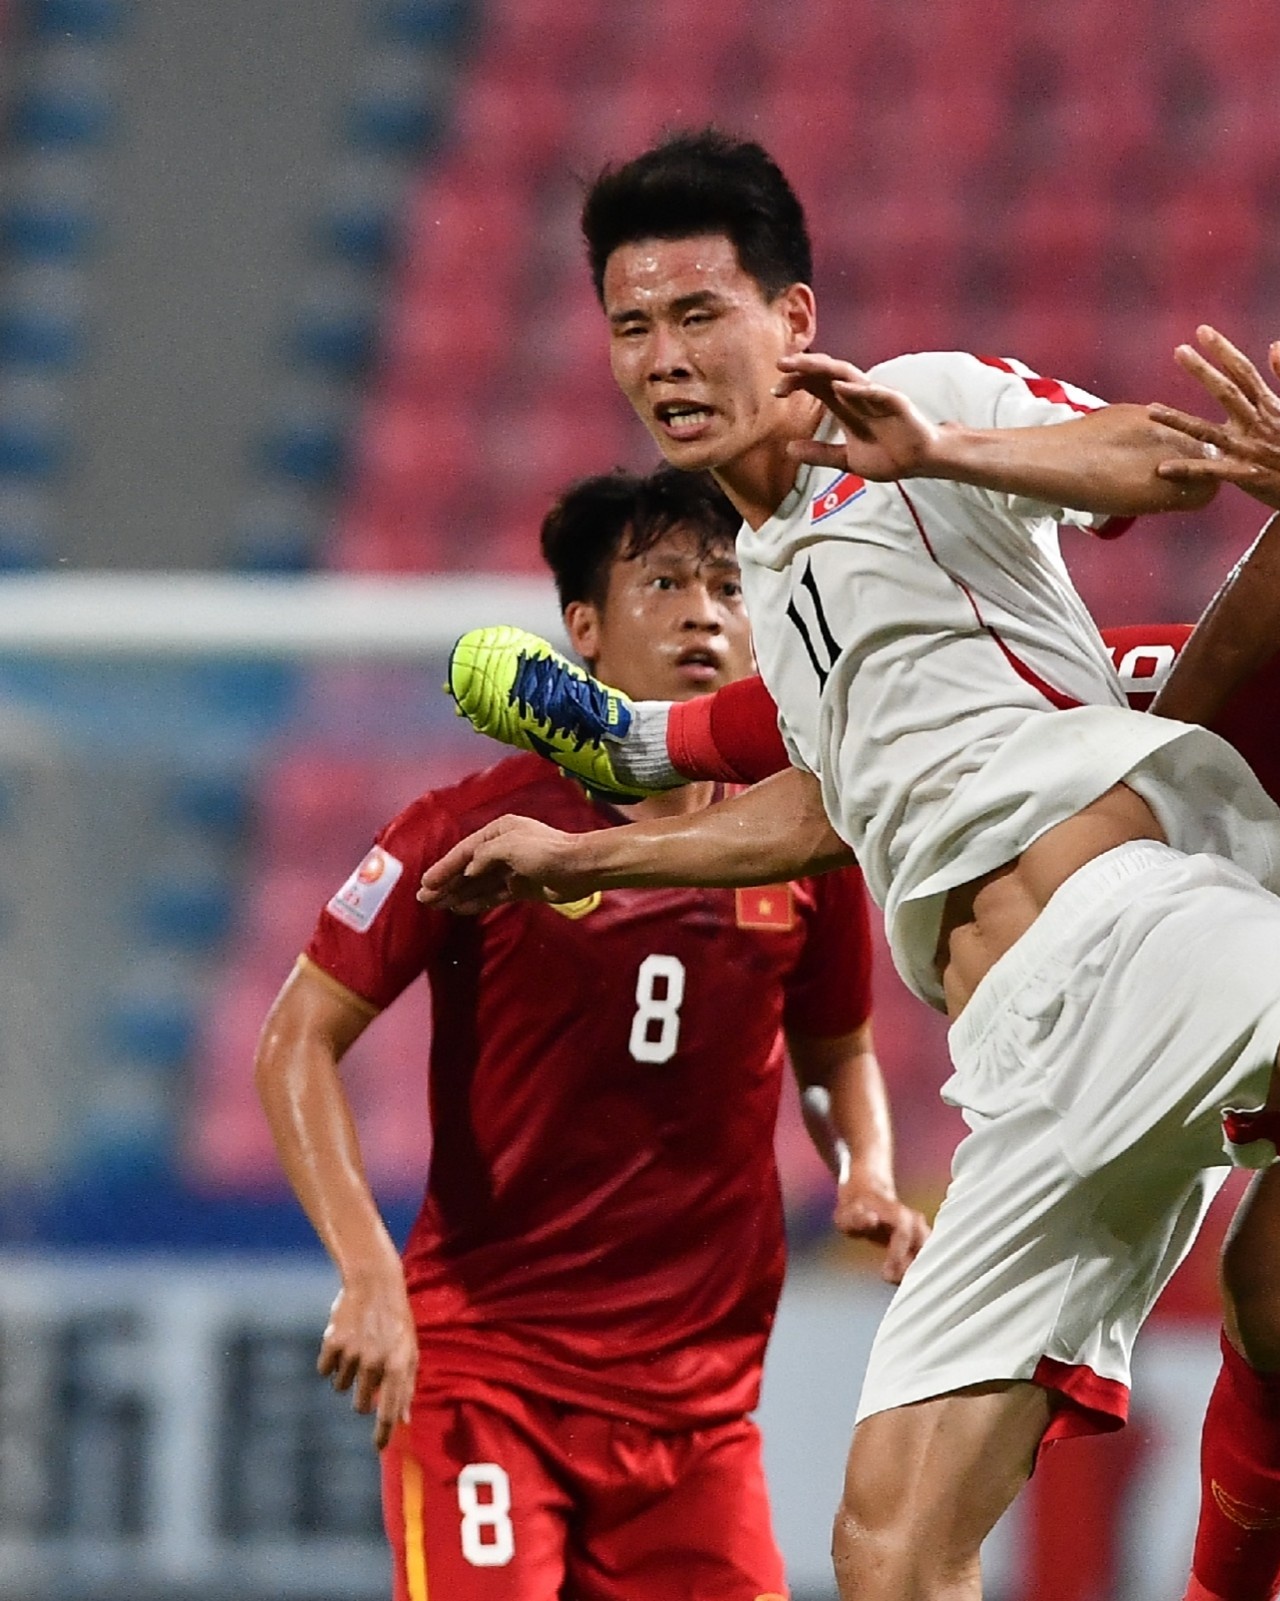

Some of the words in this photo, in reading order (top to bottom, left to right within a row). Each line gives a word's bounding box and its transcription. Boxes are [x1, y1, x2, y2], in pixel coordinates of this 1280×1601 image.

[786, 555, 843, 697] 11
[629, 954, 686, 1064] 8
[457, 1462, 515, 1567] 8
